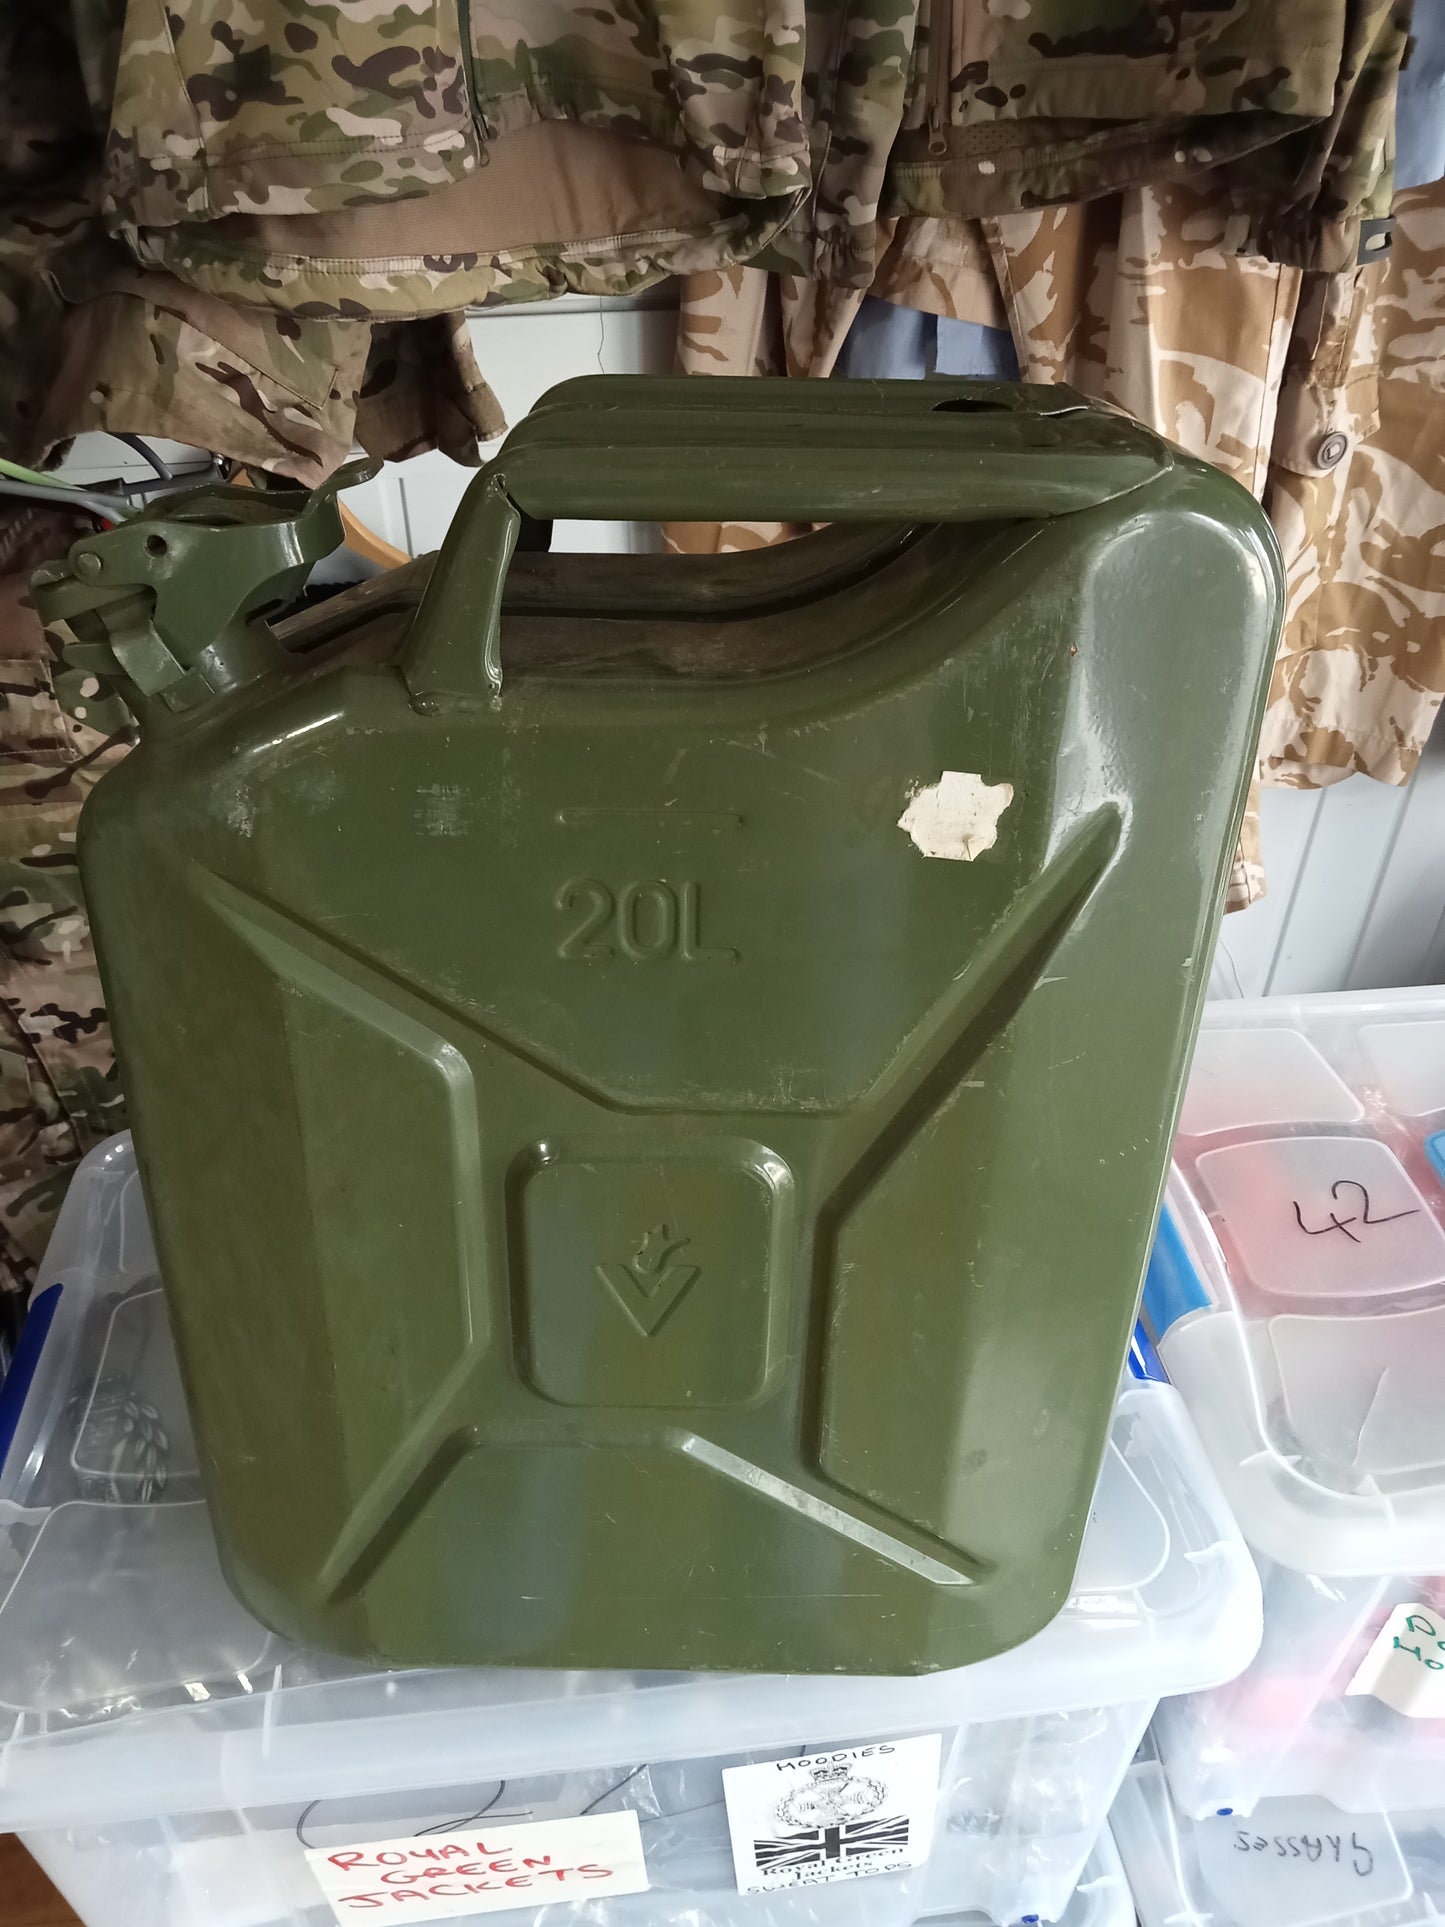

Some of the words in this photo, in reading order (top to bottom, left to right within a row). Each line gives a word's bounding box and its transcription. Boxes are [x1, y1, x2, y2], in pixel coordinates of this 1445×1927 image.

[554, 876, 742, 961] 20L
[1292, 1179, 1421, 1243] 42
[776, 1744, 896, 1772] HOODIES
[327, 1841, 512, 1871] ROYAL
[380, 1854, 551, 1884] GREEN
[762, 1859, 826, 1876] Royal
[835, 1848, 904, 1864] Green
[795, 1861, 873, 1880] Jackets
[337, 1863, 614, 1908] JACKETS
[747, 1874, 836, 1894] SWEAT
